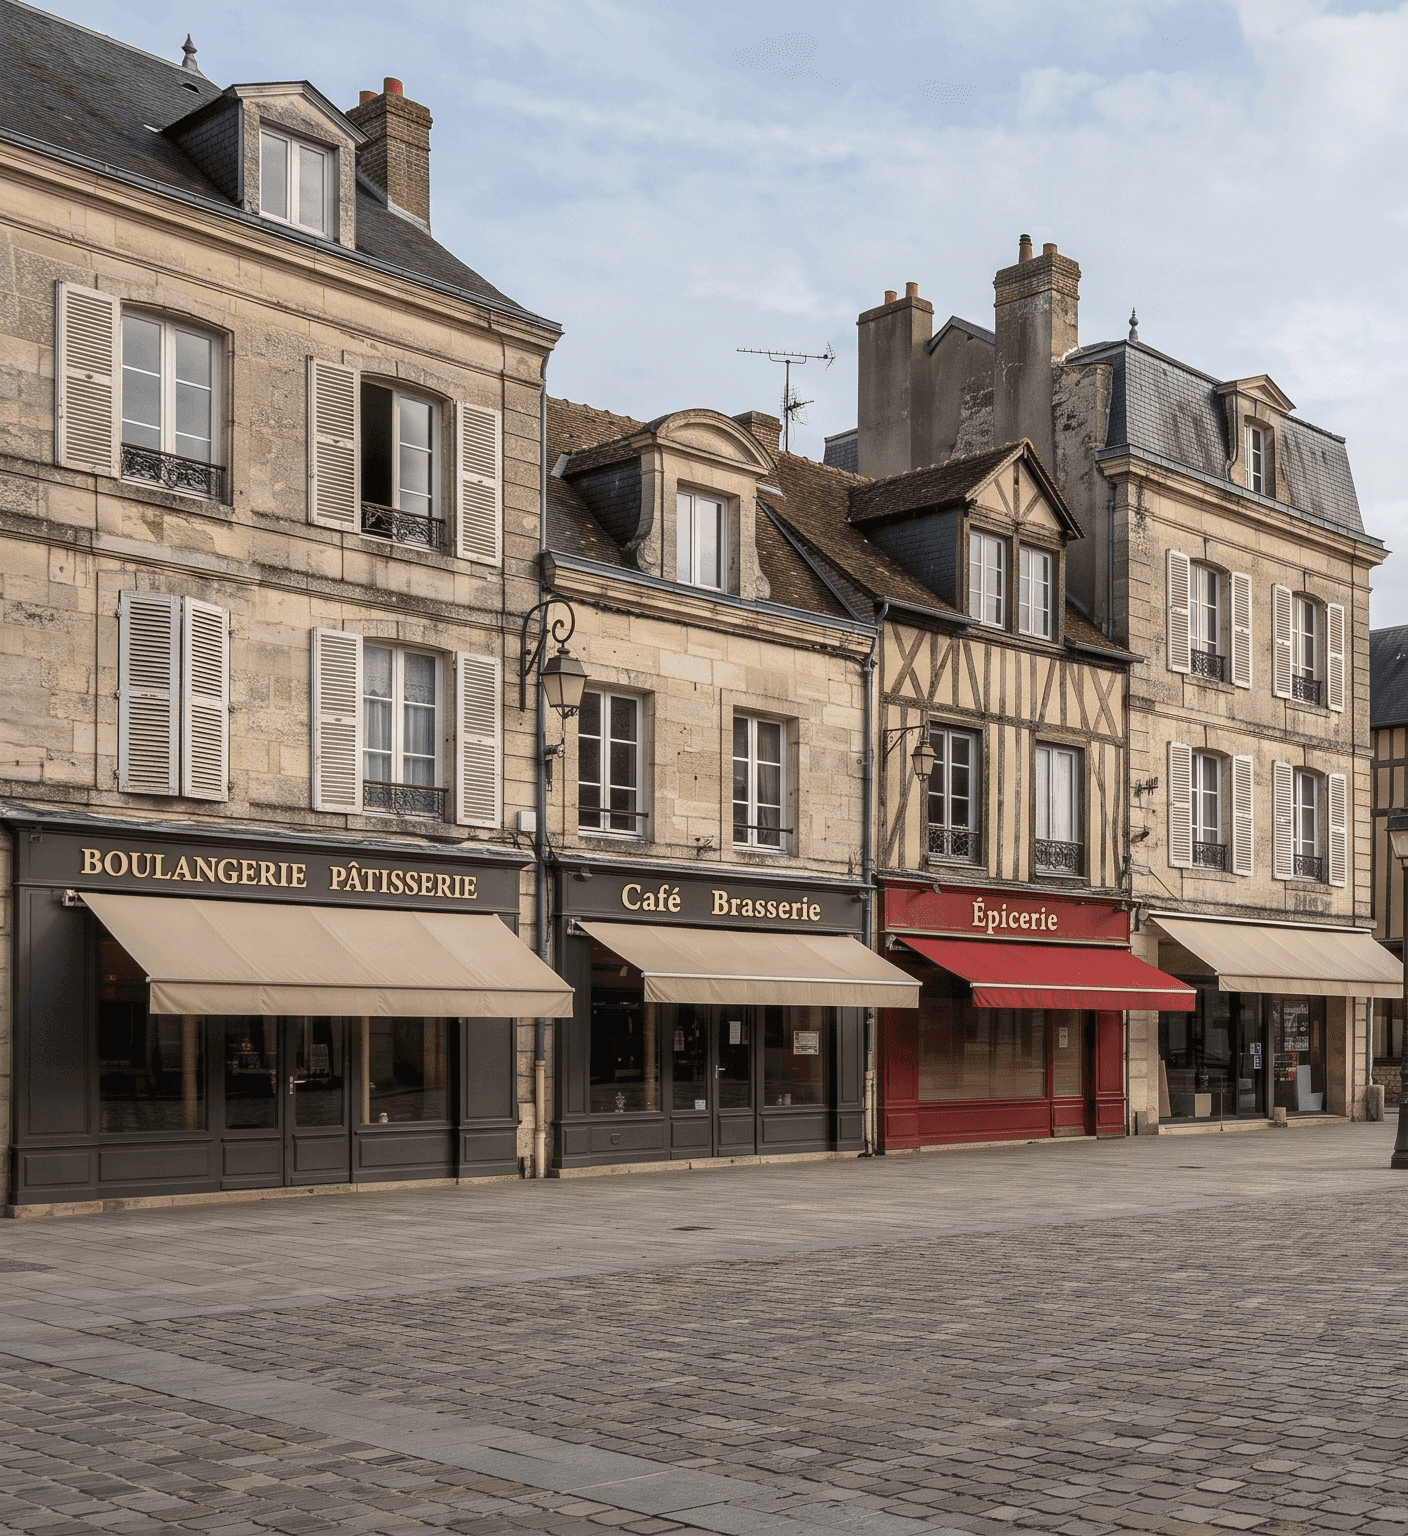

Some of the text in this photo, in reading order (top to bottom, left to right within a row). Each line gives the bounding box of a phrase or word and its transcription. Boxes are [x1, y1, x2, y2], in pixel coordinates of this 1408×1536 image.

[80, 848, 478, 900] BOULANGERIE PÂTISSERIE
[621, 883, 822, 922] Café Brasserie
[971, 896, 1059, 936] Épicerie
